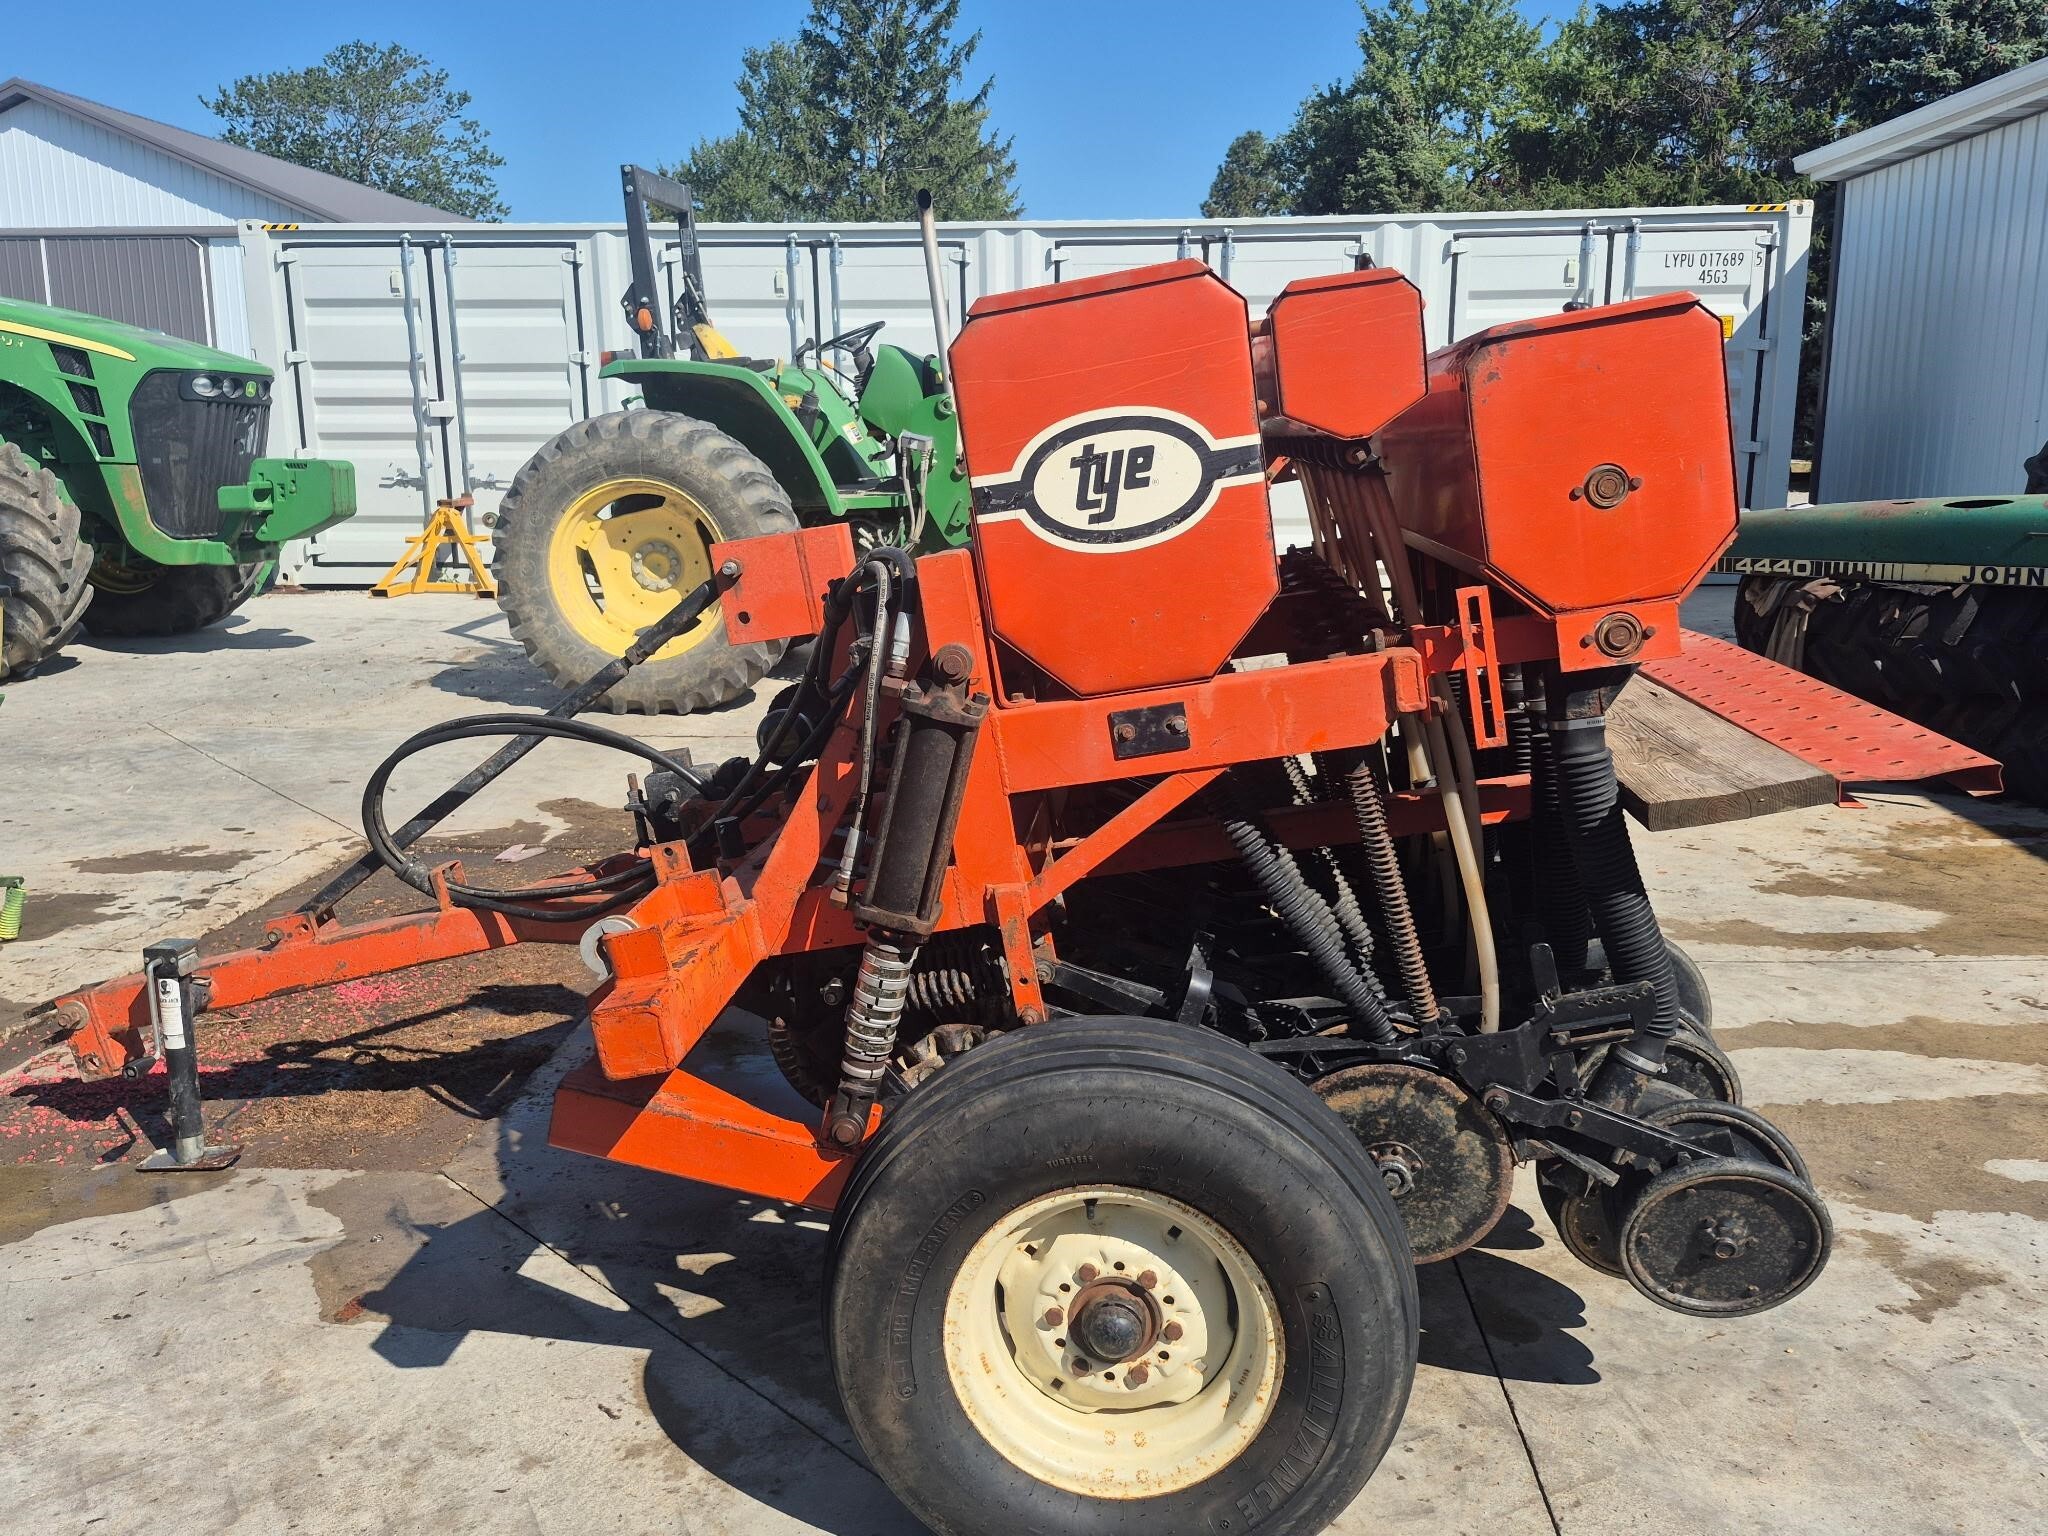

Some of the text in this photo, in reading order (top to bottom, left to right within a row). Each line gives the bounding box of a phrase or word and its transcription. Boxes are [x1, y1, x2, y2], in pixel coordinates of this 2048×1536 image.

[1664, 251, 1763, 268] LYPU 017689 5
[1698, 269, 1728, 284] 45G3
[1069, 443, 1155, 525] tye
[1735, 557, 1812, 577] 4440
[1961, 565, 2045, 586] JOHN
[1235, 1338, 1342, 1527] ALLIANCE
